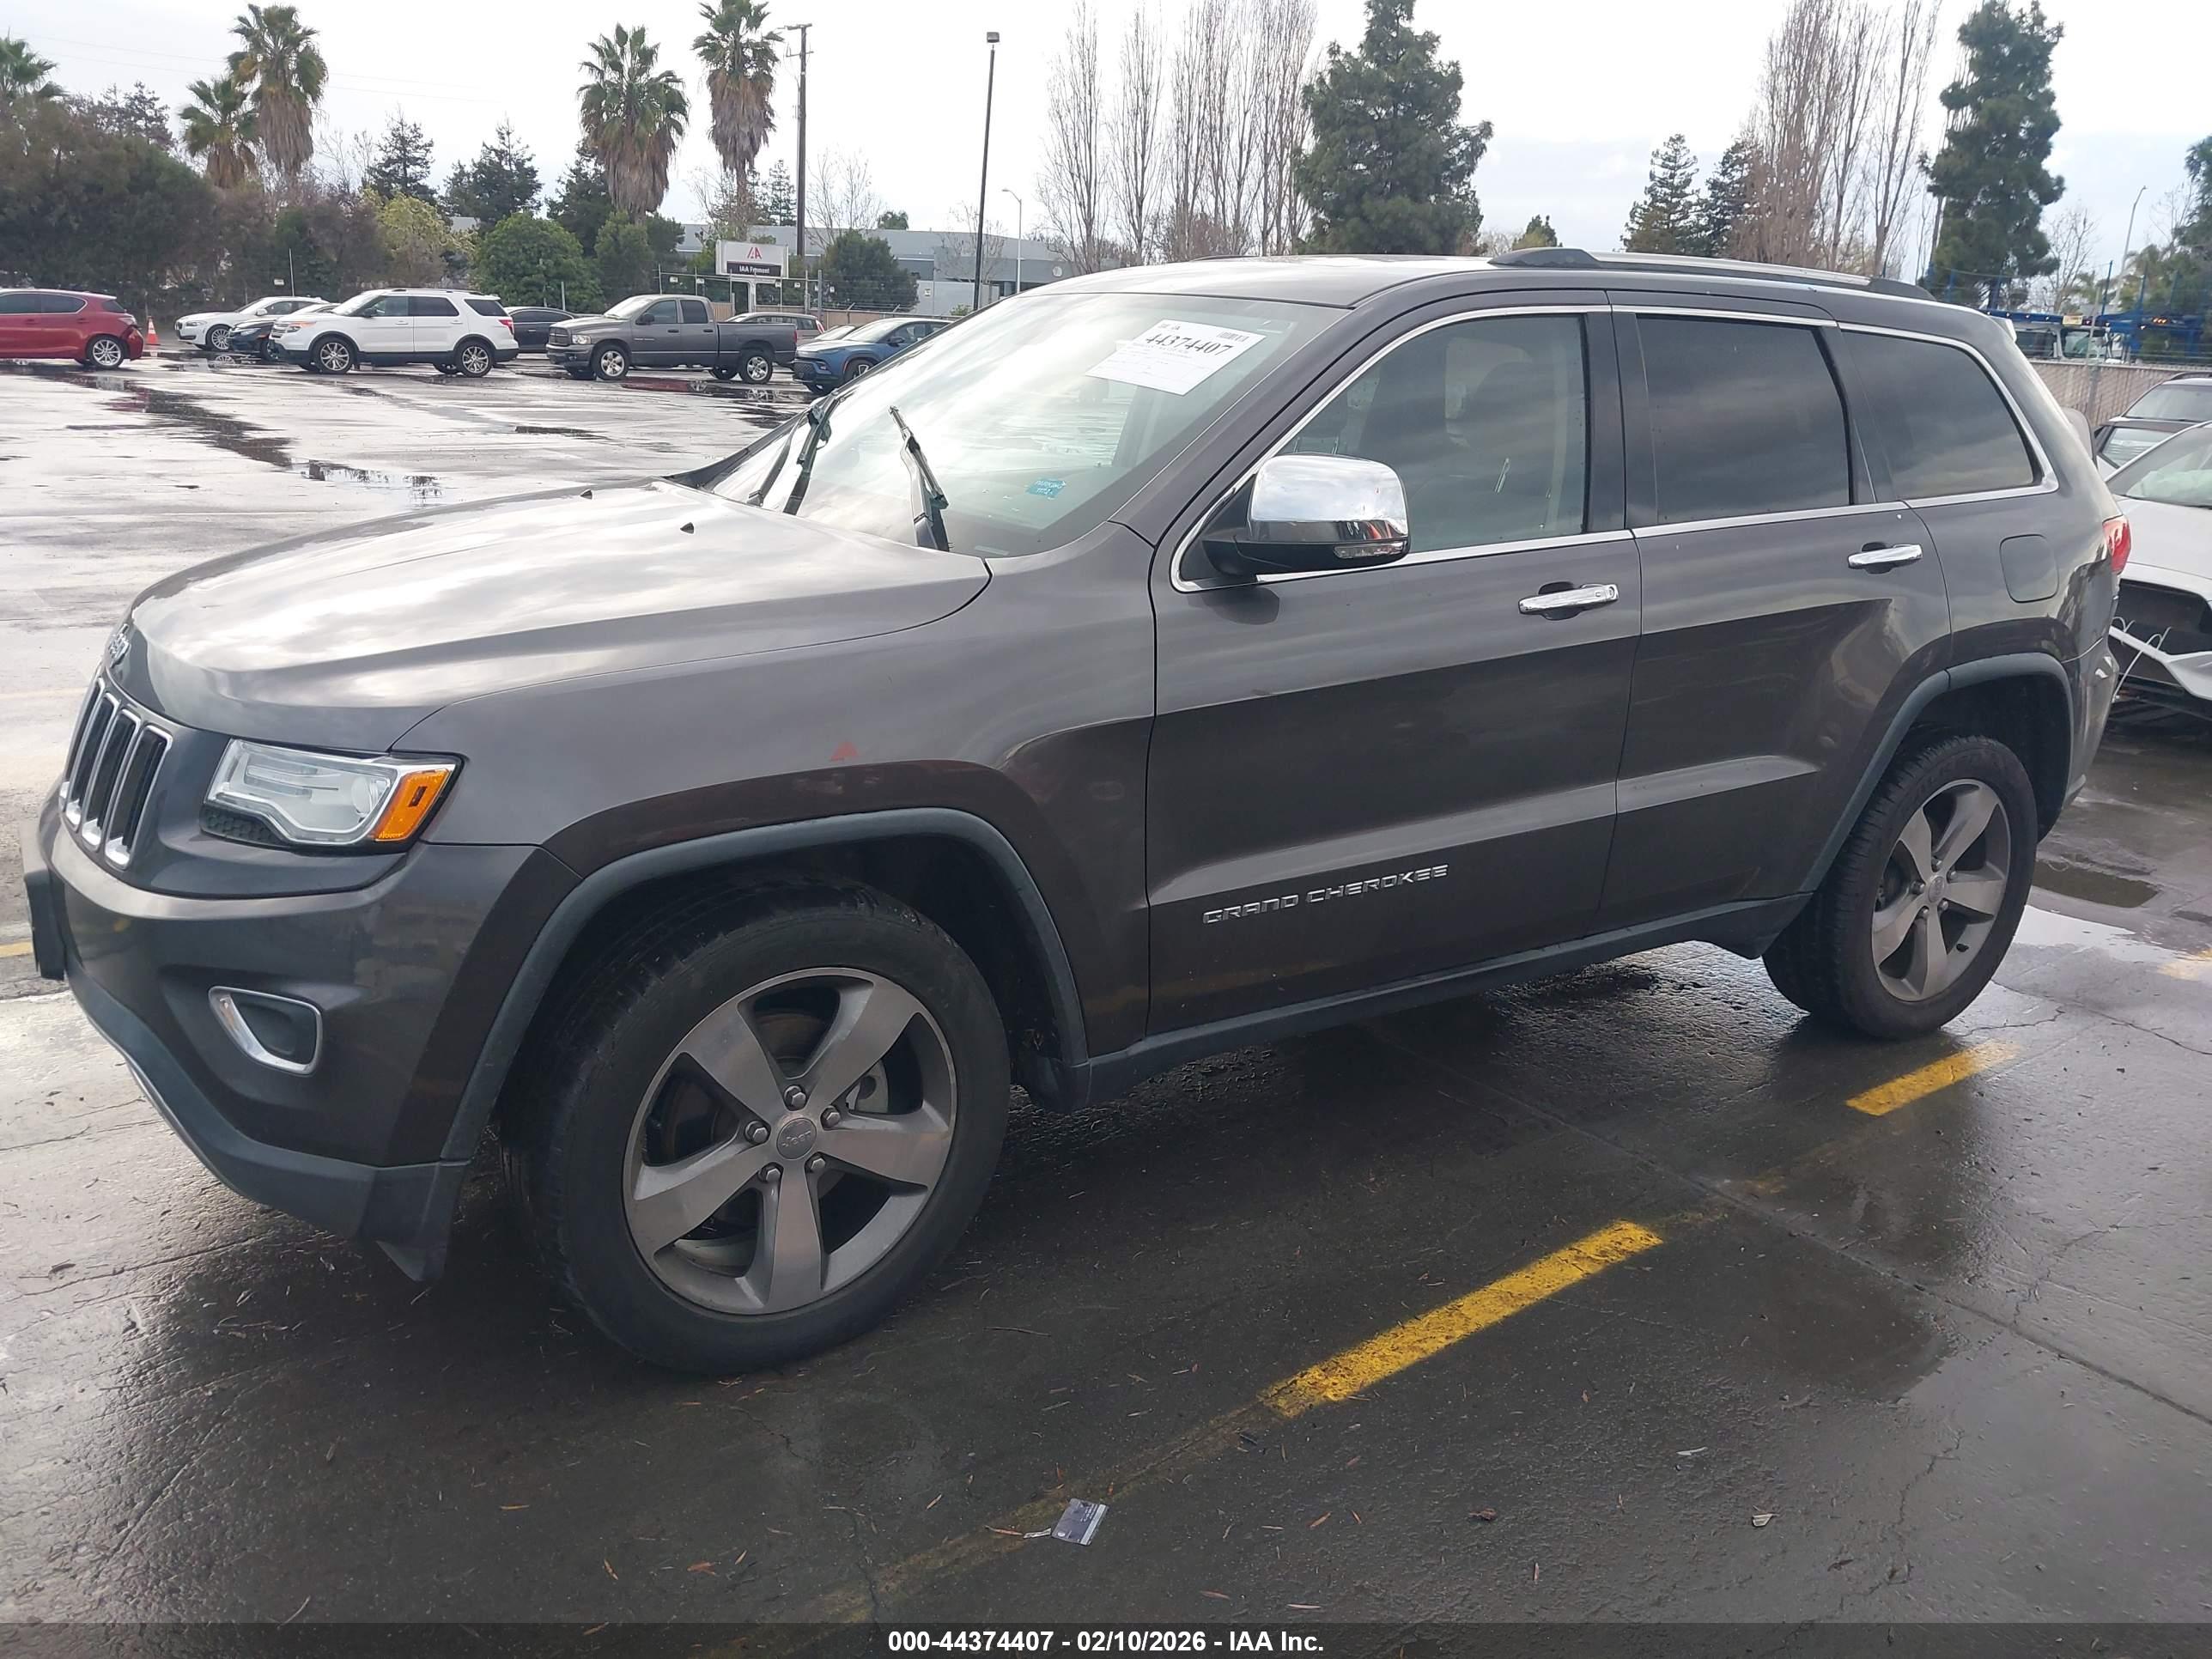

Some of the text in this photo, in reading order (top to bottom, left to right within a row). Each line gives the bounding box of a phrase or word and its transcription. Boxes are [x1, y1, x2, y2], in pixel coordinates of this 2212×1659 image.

[1145, 333, 1234, 356] 44374407
[1203, 864, 1449, 924] GRAND CHEROKEE
